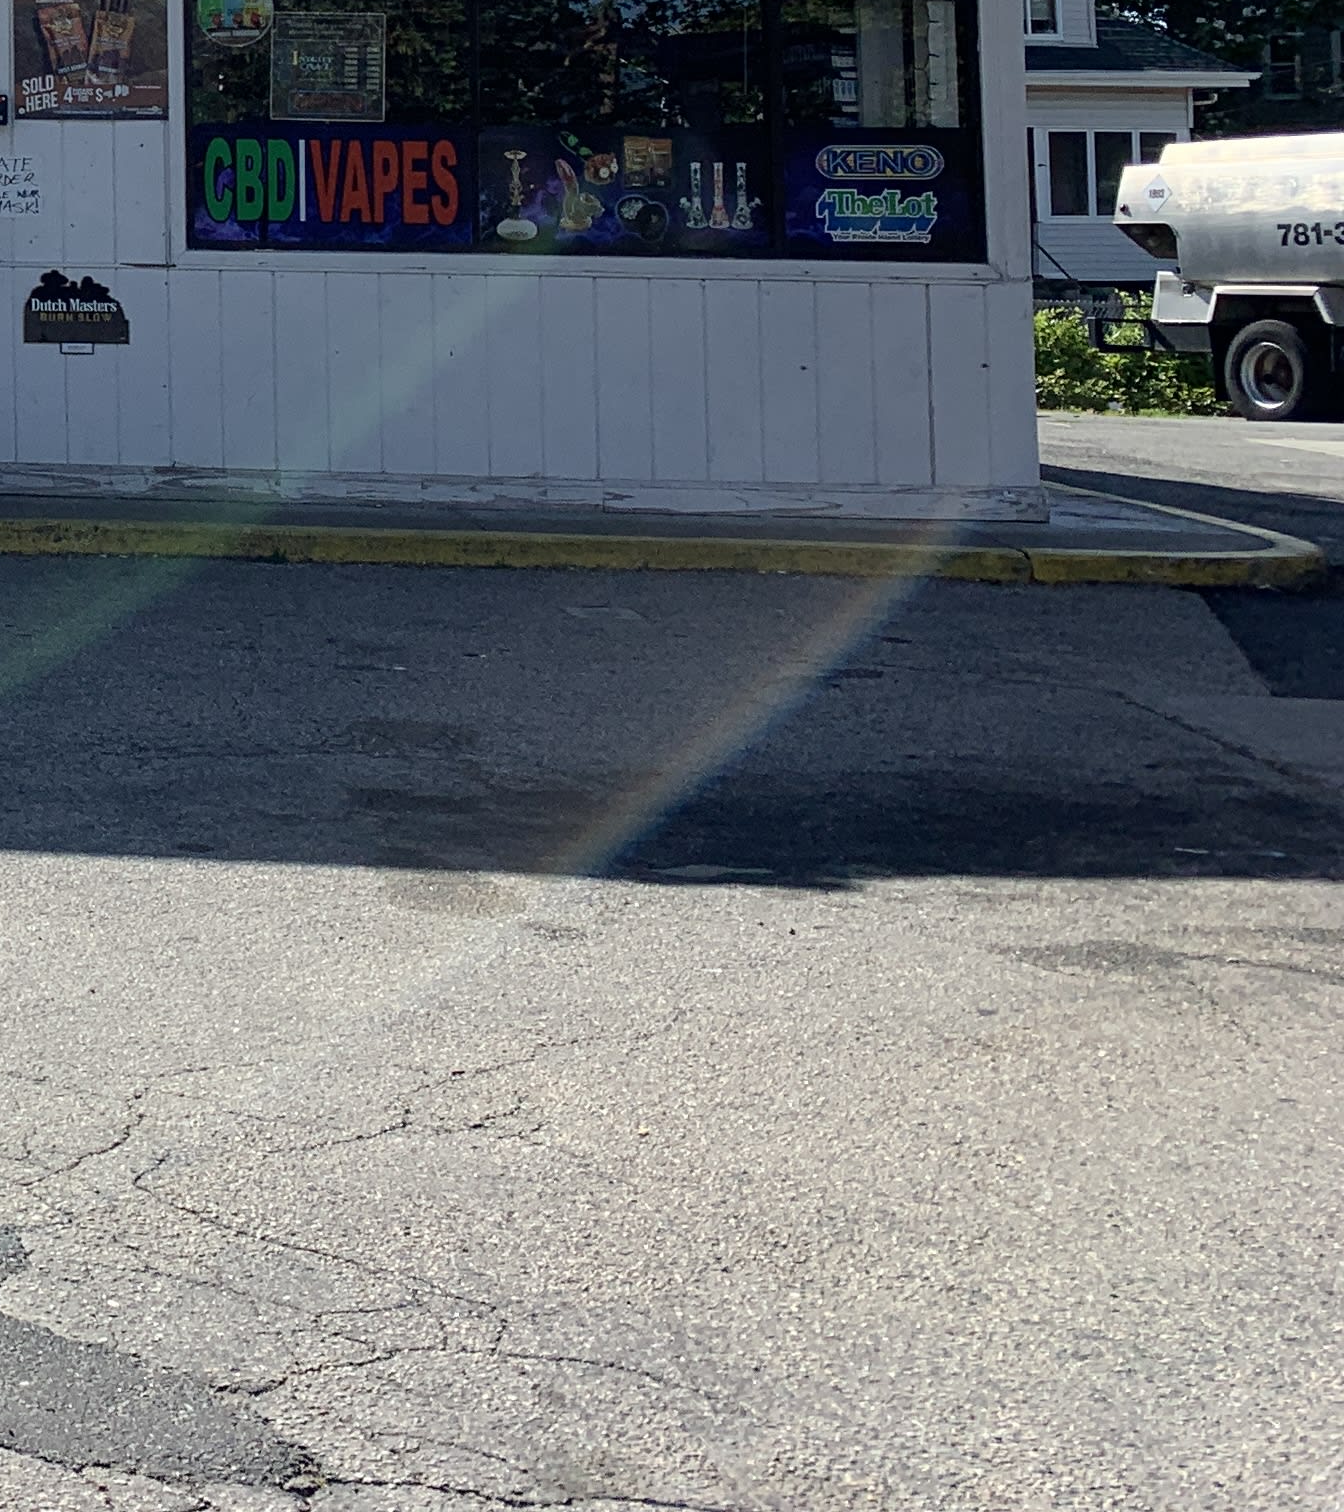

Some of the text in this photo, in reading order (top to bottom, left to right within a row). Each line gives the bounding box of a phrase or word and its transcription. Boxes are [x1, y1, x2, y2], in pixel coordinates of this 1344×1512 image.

[22, 74, 55, 95] SOLD
[63, 86, 73, 103] 4
[25, 91, 59, 113] HERE
[827, 150, 933, 174] KENO
[204, 137, 458, 226] CBD VAPES
[31, 297, 117, 312] Dutch Masters
[40, 312, 113, 322] BURN SLOW
